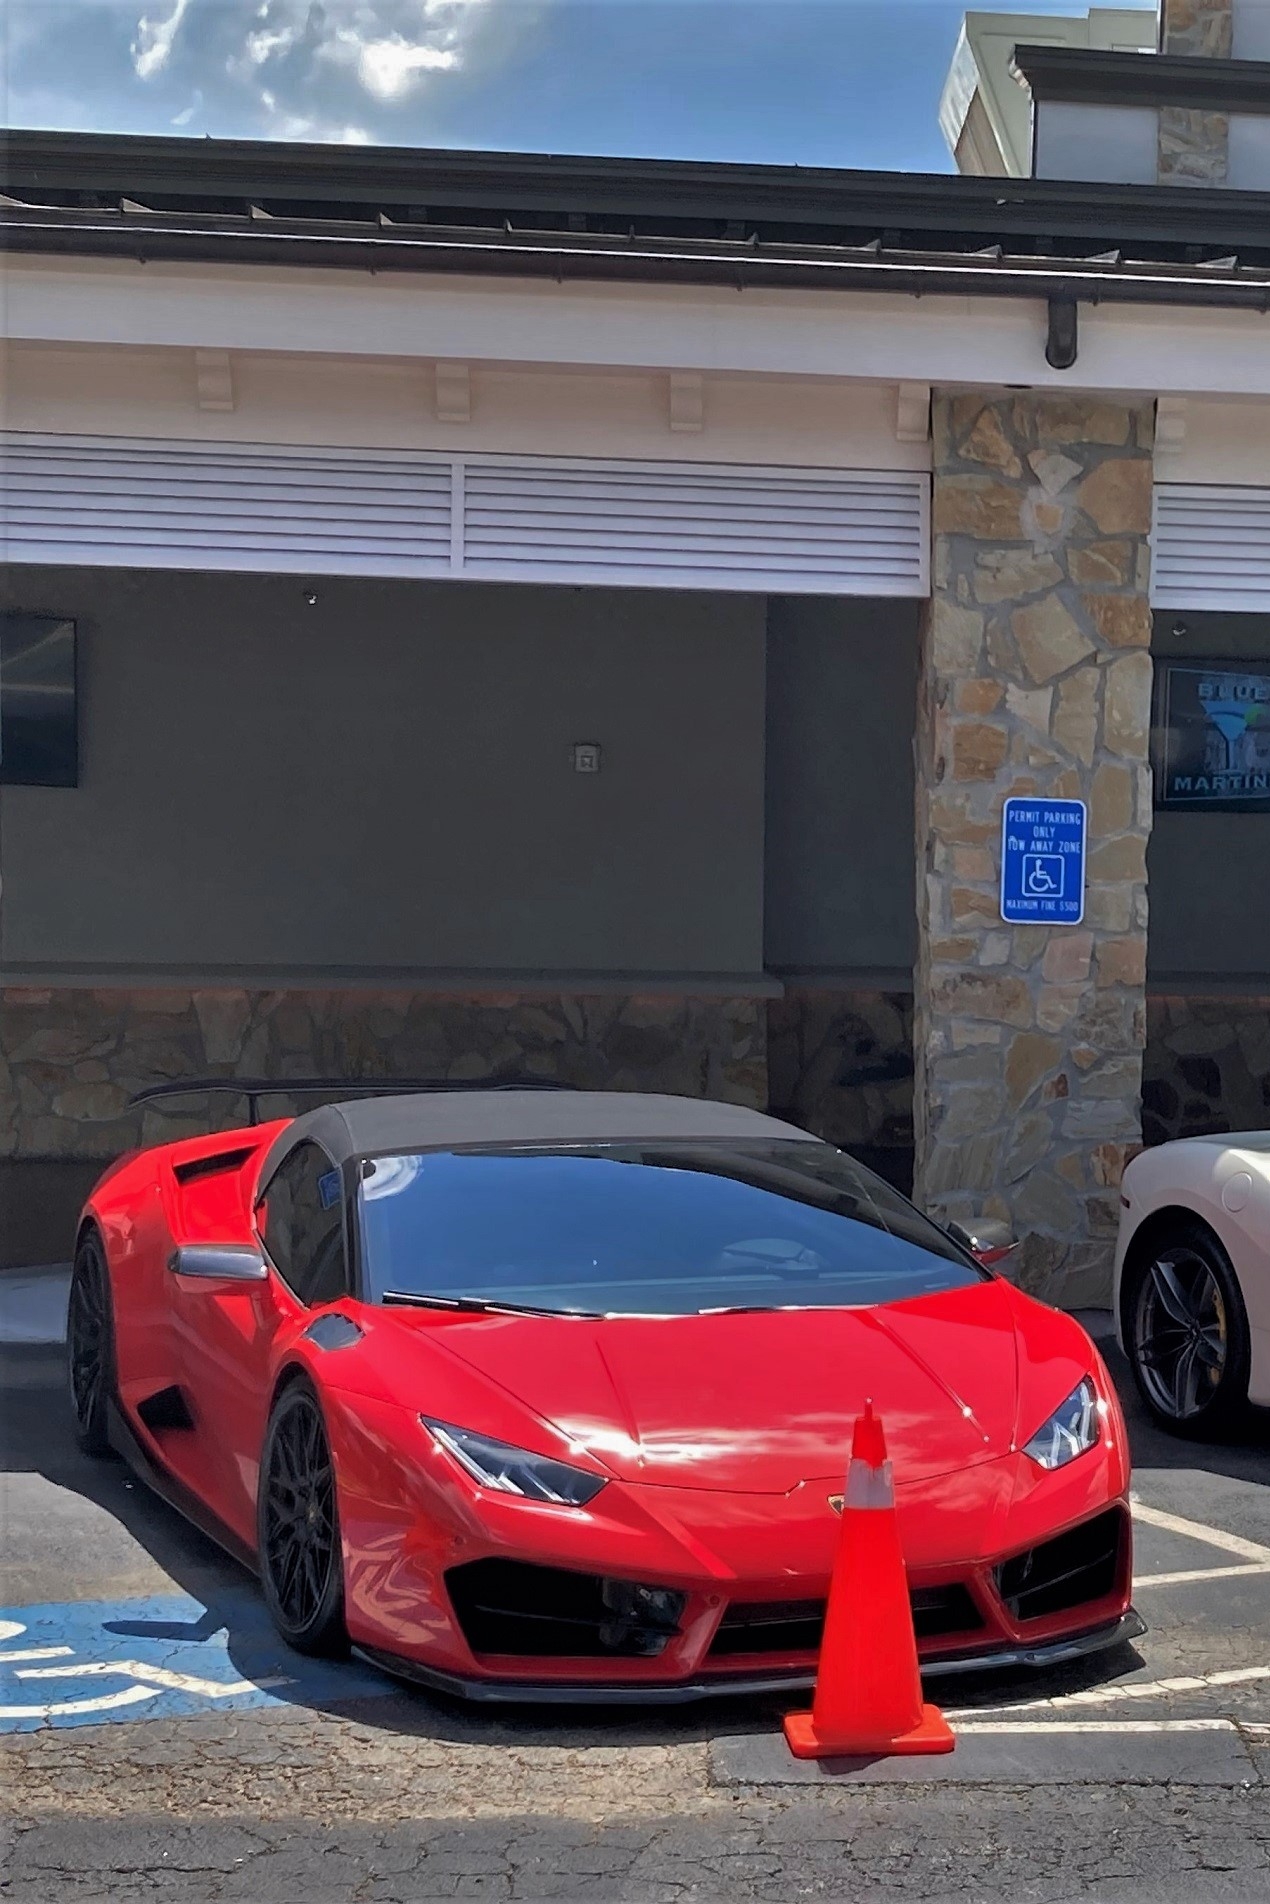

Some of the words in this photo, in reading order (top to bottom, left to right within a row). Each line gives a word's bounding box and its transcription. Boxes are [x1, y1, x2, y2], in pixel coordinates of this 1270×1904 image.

[1198, 683, 1268, 700] BLUE
[1008, 810, 1040, 823] PERMIT
[1043, 811, 1081, 825] PARKING
[1033, 825, 1056, 838] ONLY
[1030, 840, 1054, 852] AWAY
[1058, 841, 1081, 853] ZONE
